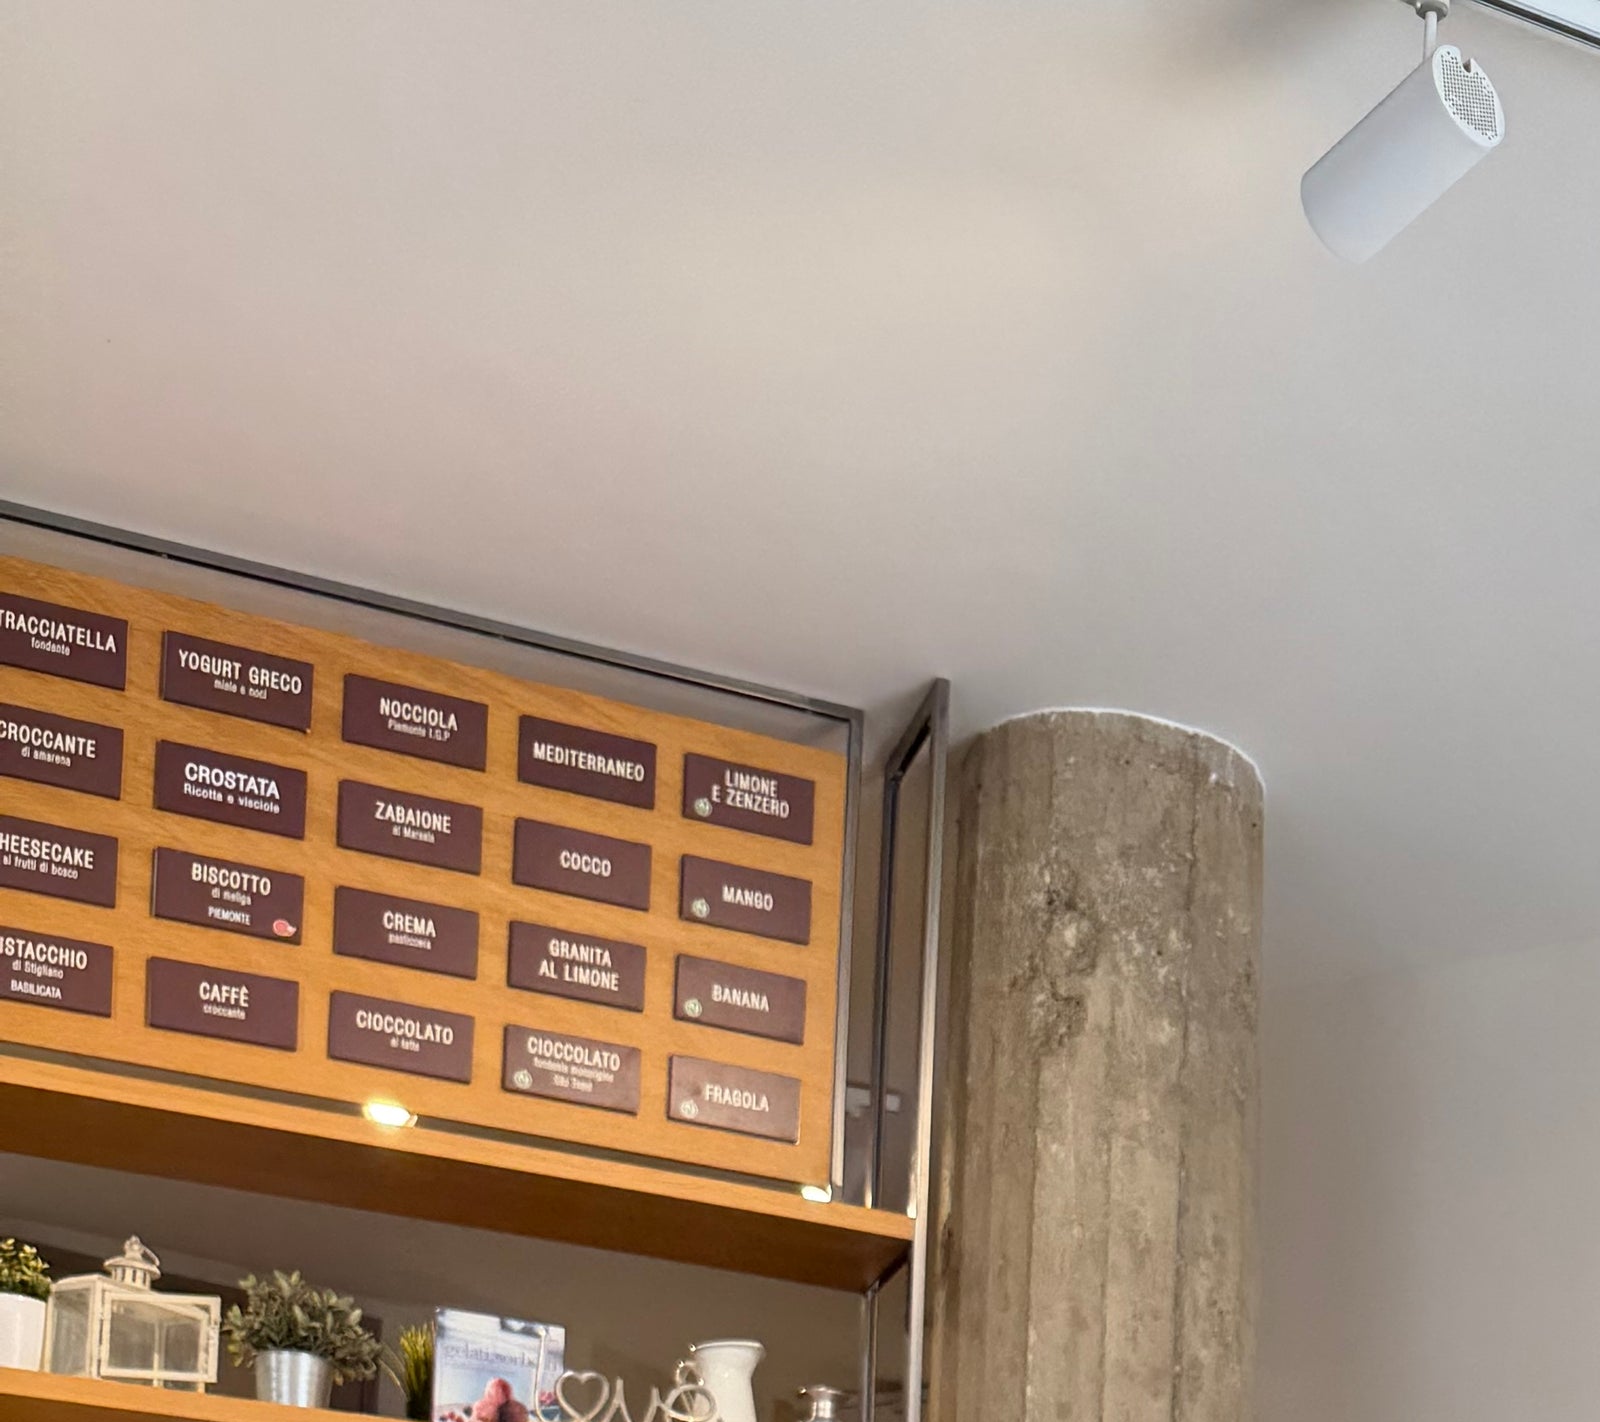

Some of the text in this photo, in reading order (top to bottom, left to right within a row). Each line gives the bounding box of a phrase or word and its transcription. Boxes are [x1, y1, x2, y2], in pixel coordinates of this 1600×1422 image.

[178, 648, 302, 694] YOGURT GRECO
[380, 697, 458, 732] NOCCIOLA
[0, 719, 97, 759] CROCCANTE
[21, 746, 71, 767] di amarena
[532, 741, 645, 782] MEDITERRANEO
[184, 762, 280, 800] CROSTATA
[724, 769, 778, 797] LIMONE
[184, 782, 280, 814] Ricotta e visciole
[711, 784, 790, 819] E ZENZERO
[374, 800, 452, 834] ZABAIONE
[14, 856, 37, 871] frutti
[39, 861, 49, 873] di
[51, 863, 79, 880] bosco
[560, 850, 612, 877] COCCO
[191, 862, 271, 896] BISCOTTO
[211, 887, 220, 899] di
[721, 884, 774, 912] MANGO
[208, 905, 251, 926] PIEMONTE
[382, 910, 437, 938] CREMA
[549, 938, 612, 968] GRANITA
[12, 959, 64, 979] di Stigliano
[538, 959, 620, 992] AL LIMONE
[10, 979, 62, 1000] BASILICATA
[711, 983, 770, 1013] BANANA
[356, 1009, 454, 1046] CIOCCOLATO
[527, 1036, 620, 1072] CIOCCOLATO
[704, 1083, 769, 1112] FRAGOLA
